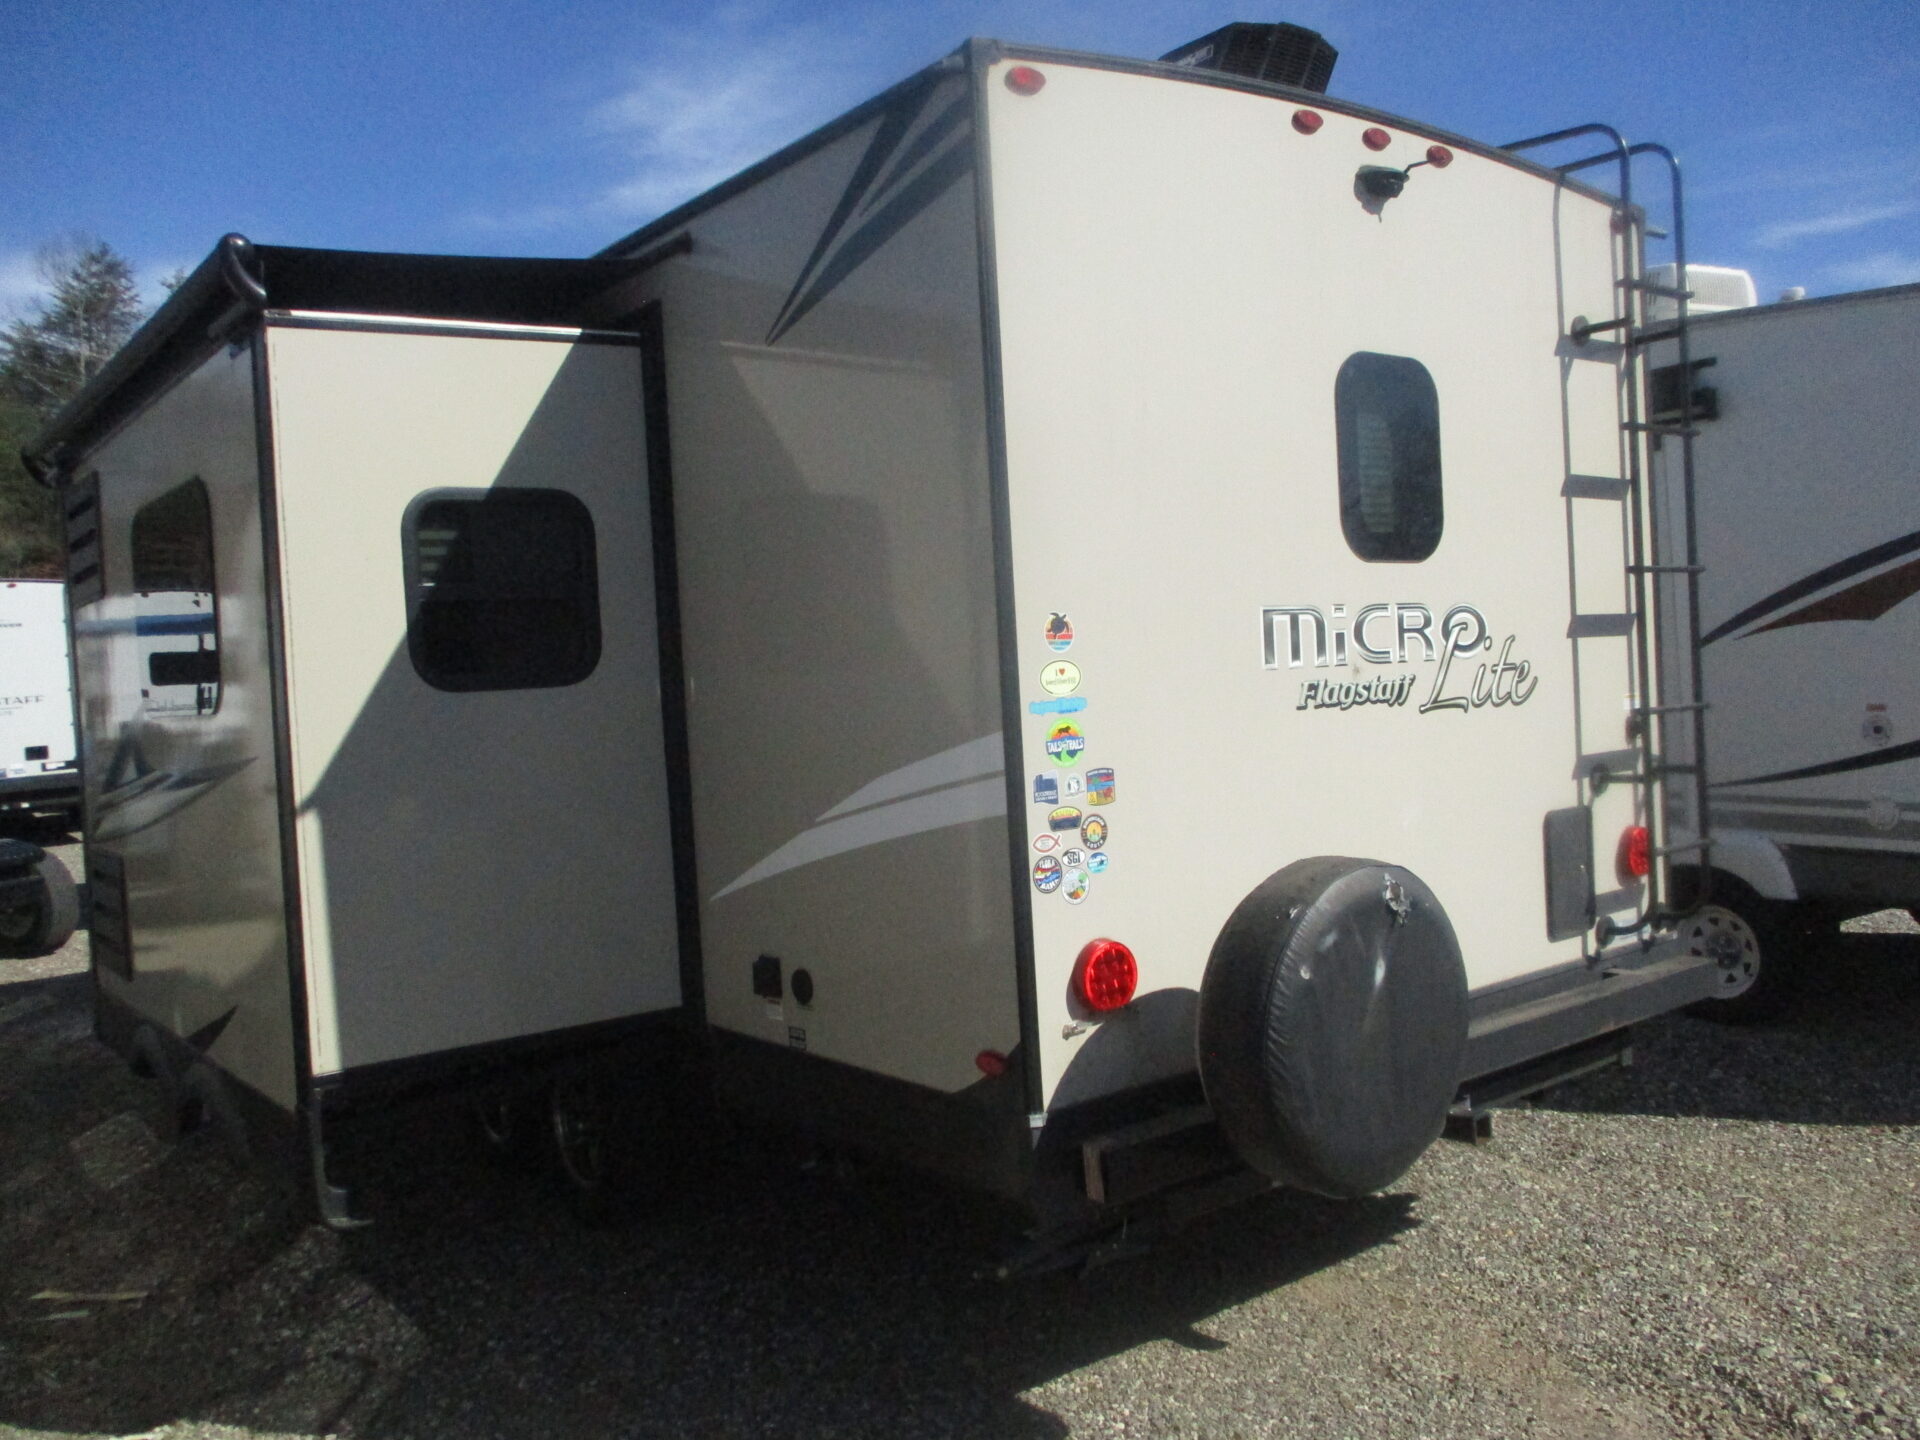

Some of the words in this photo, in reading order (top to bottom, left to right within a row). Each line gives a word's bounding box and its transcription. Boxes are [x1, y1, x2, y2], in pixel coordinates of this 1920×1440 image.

[1419, 622, 1538, 714] Lite
[1296, 674, 1416, 711] Flagstaff
[1047, 741, 1062, 753] TAILS
[1067, 851, 1081, 865] SGI
